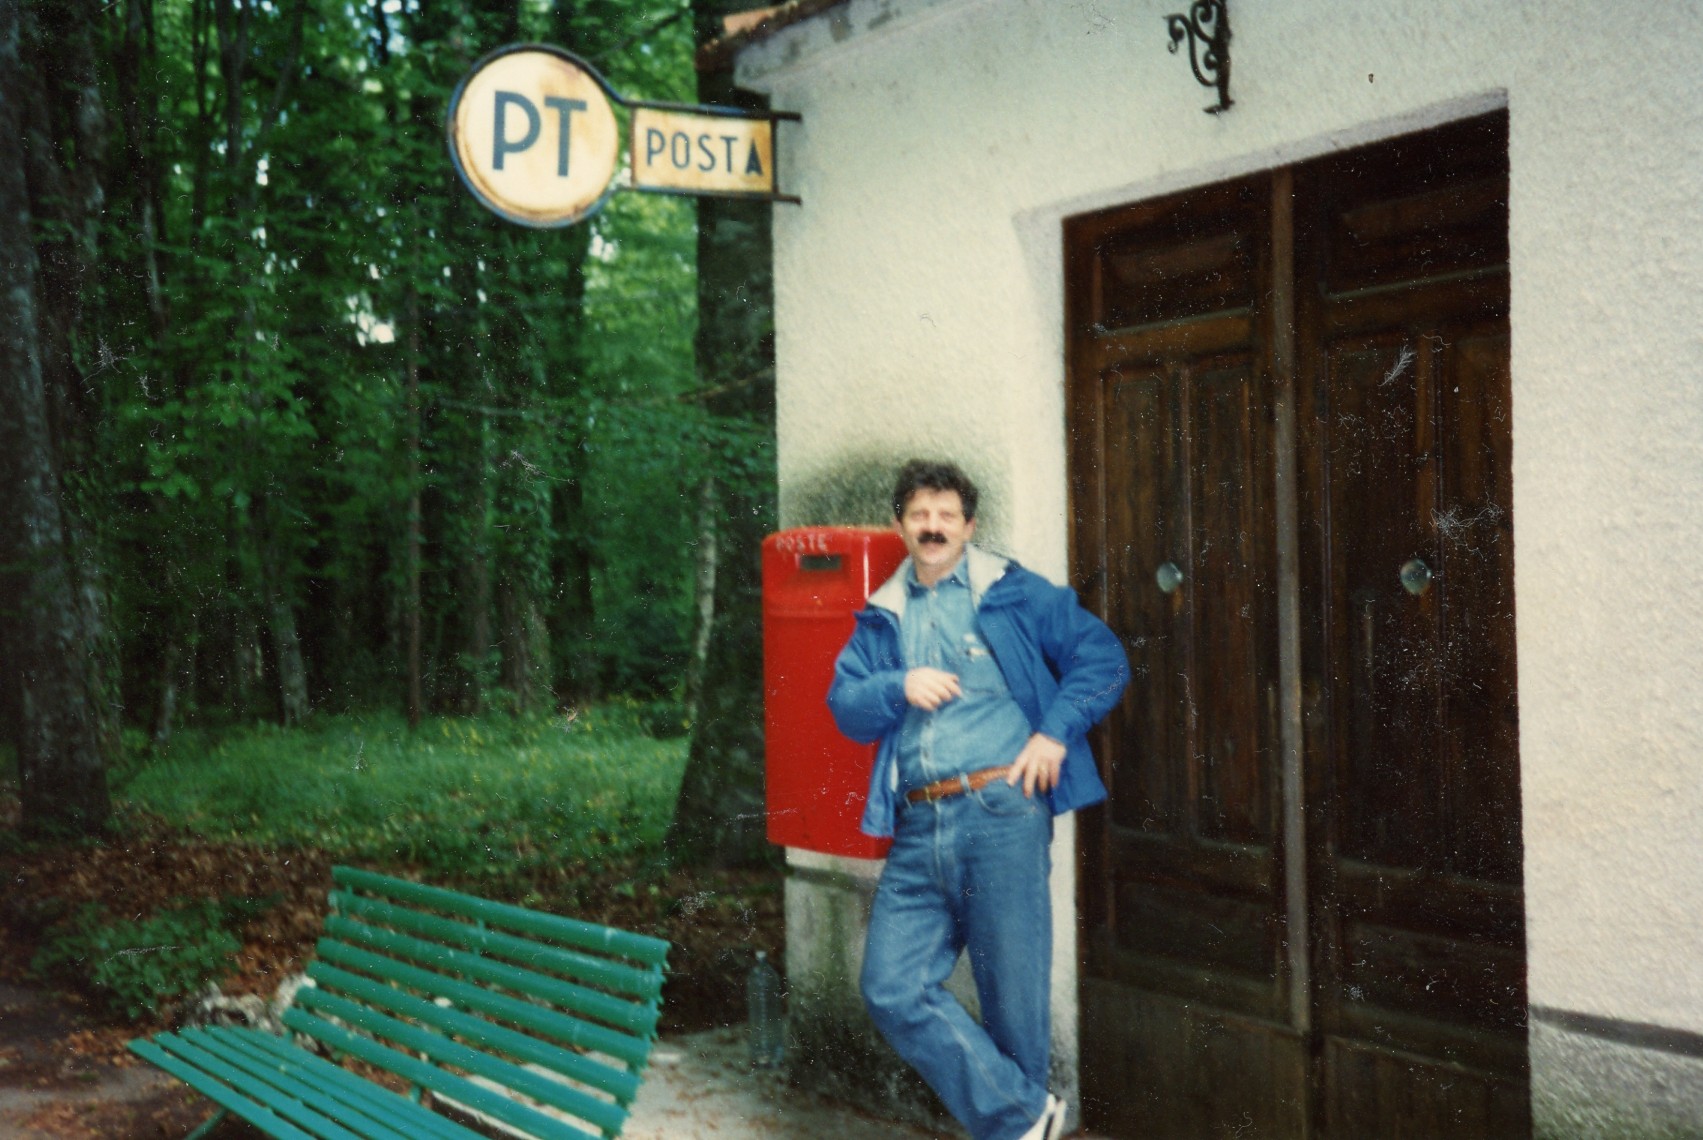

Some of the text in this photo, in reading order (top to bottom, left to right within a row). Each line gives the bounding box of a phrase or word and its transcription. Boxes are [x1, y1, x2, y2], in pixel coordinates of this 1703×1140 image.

[492, 90, 588, 177] PT
[646, 128, 763, 176] POSTA
[775, 533, 828, 551] POSTE
